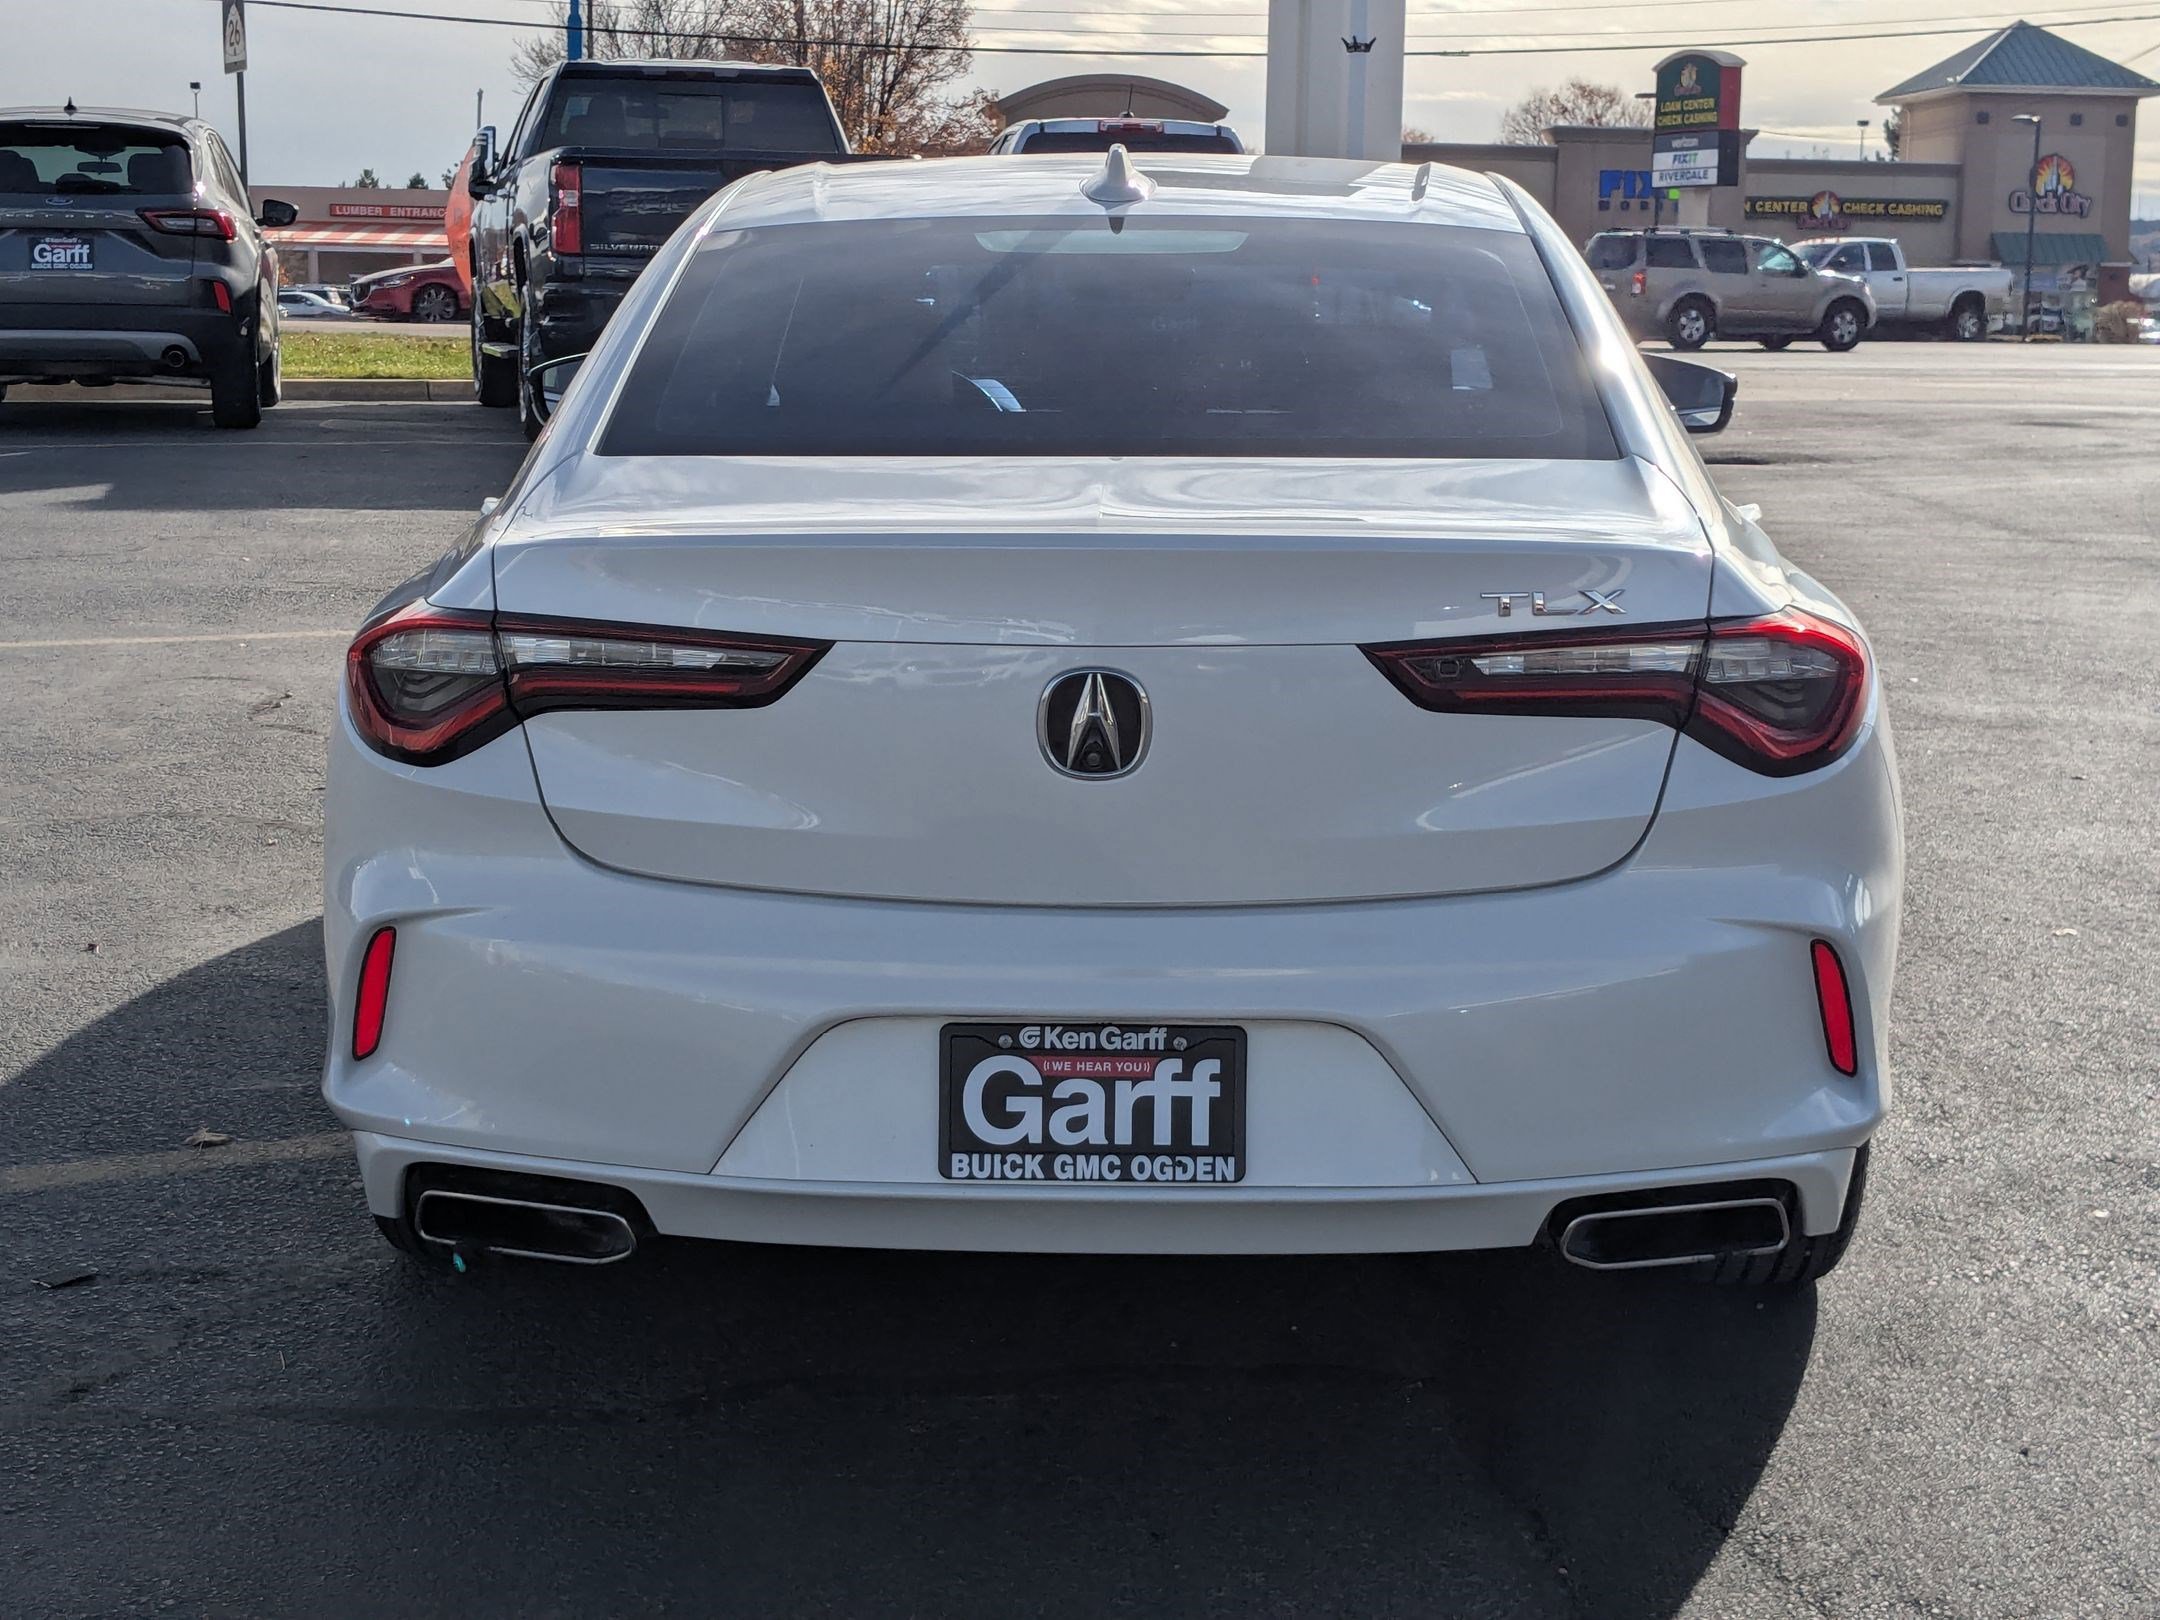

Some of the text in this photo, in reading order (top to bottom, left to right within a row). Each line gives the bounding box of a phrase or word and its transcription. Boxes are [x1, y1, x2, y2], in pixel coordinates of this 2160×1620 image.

[229, 19, 241, 47] 26
[1658, 169, 1709, 182] RIVERDALE
[335, 205, 383, 216] LUMBER
[1755, 201, 1808, 213] CENTER
[1843, 202, 1885, 215] CHECK
[1887, 203, 1943, 216] CASHING
[33, 243, 90, 263] Garff
[1480, 589, 1628, 617] TLX
[1044, 1026, 1167, 1051] Ken Garff
[1076, 1061, 1112, 1072] HEAR
[962, 1055, 1221, 1146] Garff
[951, 1153, 1235, 1182] BUICK GMC OGDEN
